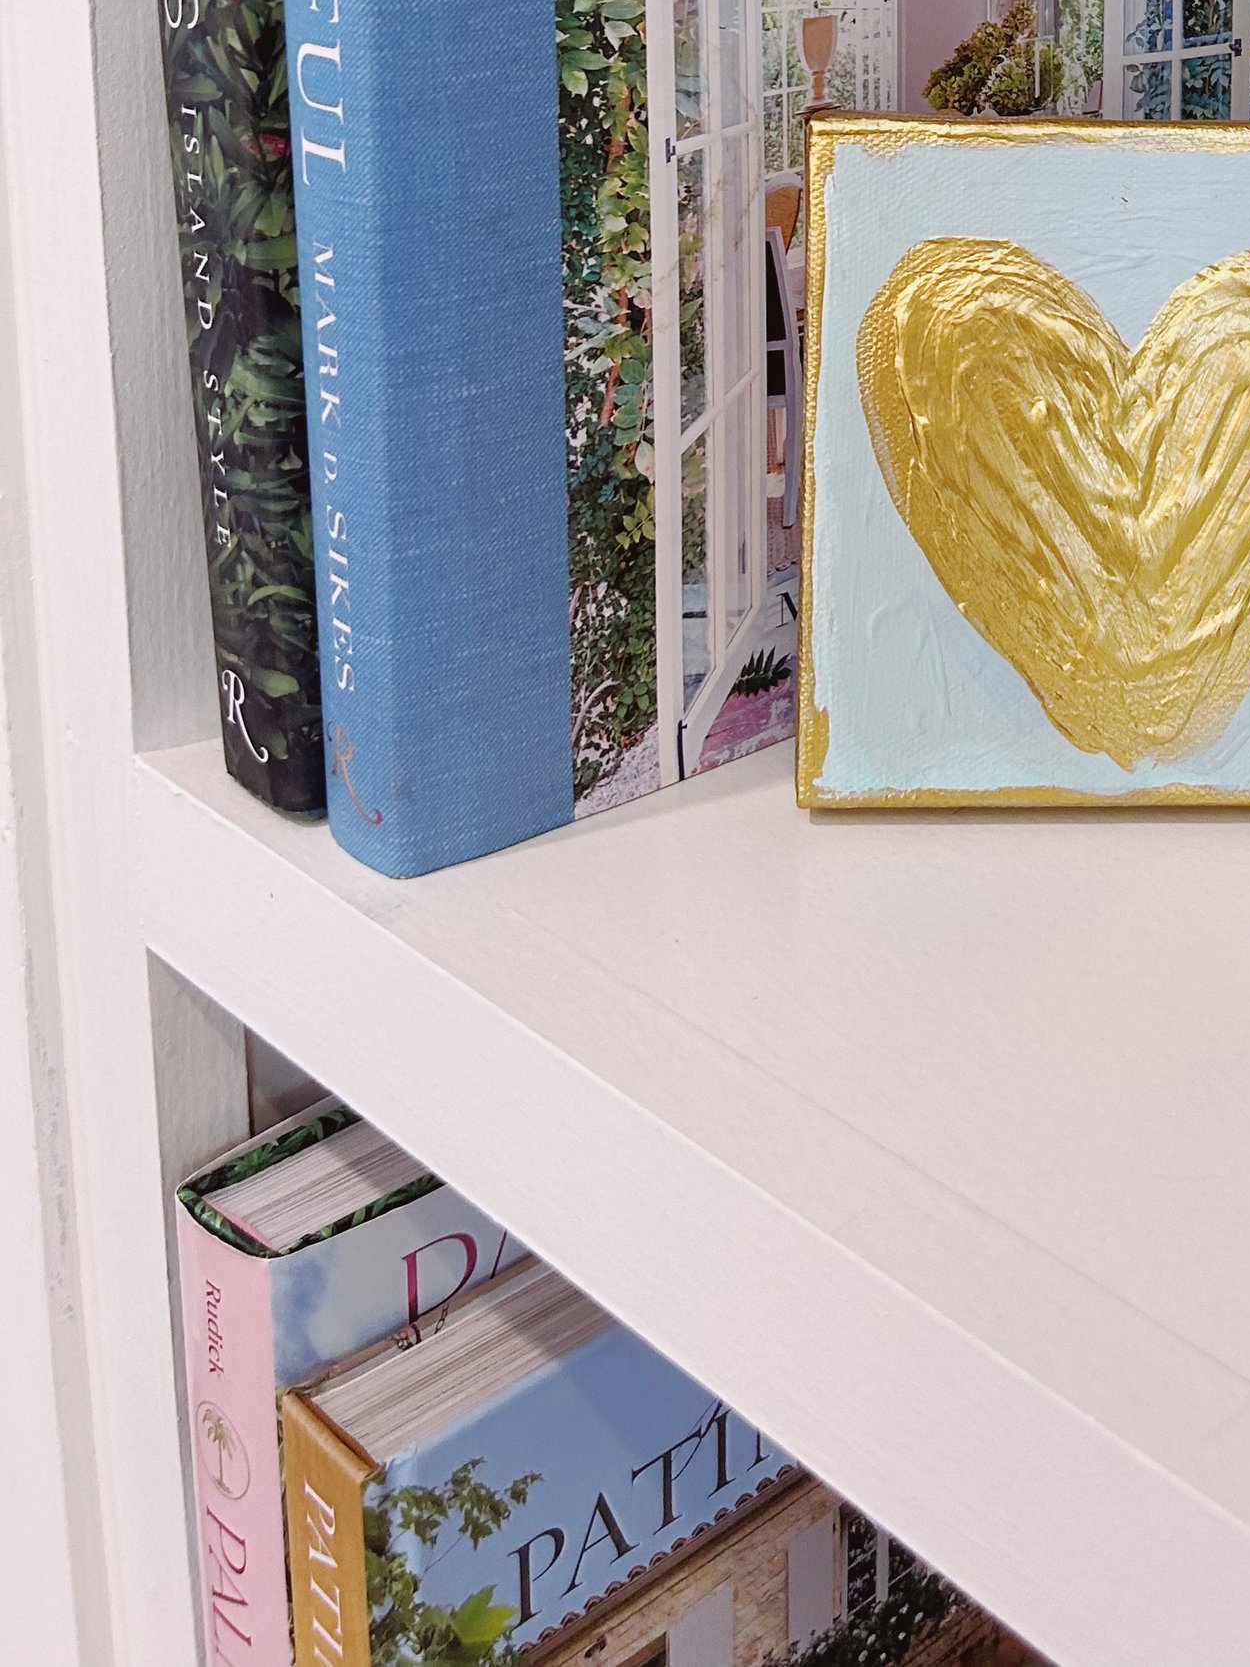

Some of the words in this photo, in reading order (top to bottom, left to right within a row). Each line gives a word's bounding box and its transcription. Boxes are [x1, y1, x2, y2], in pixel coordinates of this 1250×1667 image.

[181, 103, 214, 331] ISLAND
[203, 369, 232, 547] STYLE
[313, 240, 341, 429] MARK
[326, 503, 355, 693] SIKES
[205, 1278, 224, 1375] Rudick
[207, 1505, 253, 1667] PAL
[304, 1475, 344, 1667] PATI
